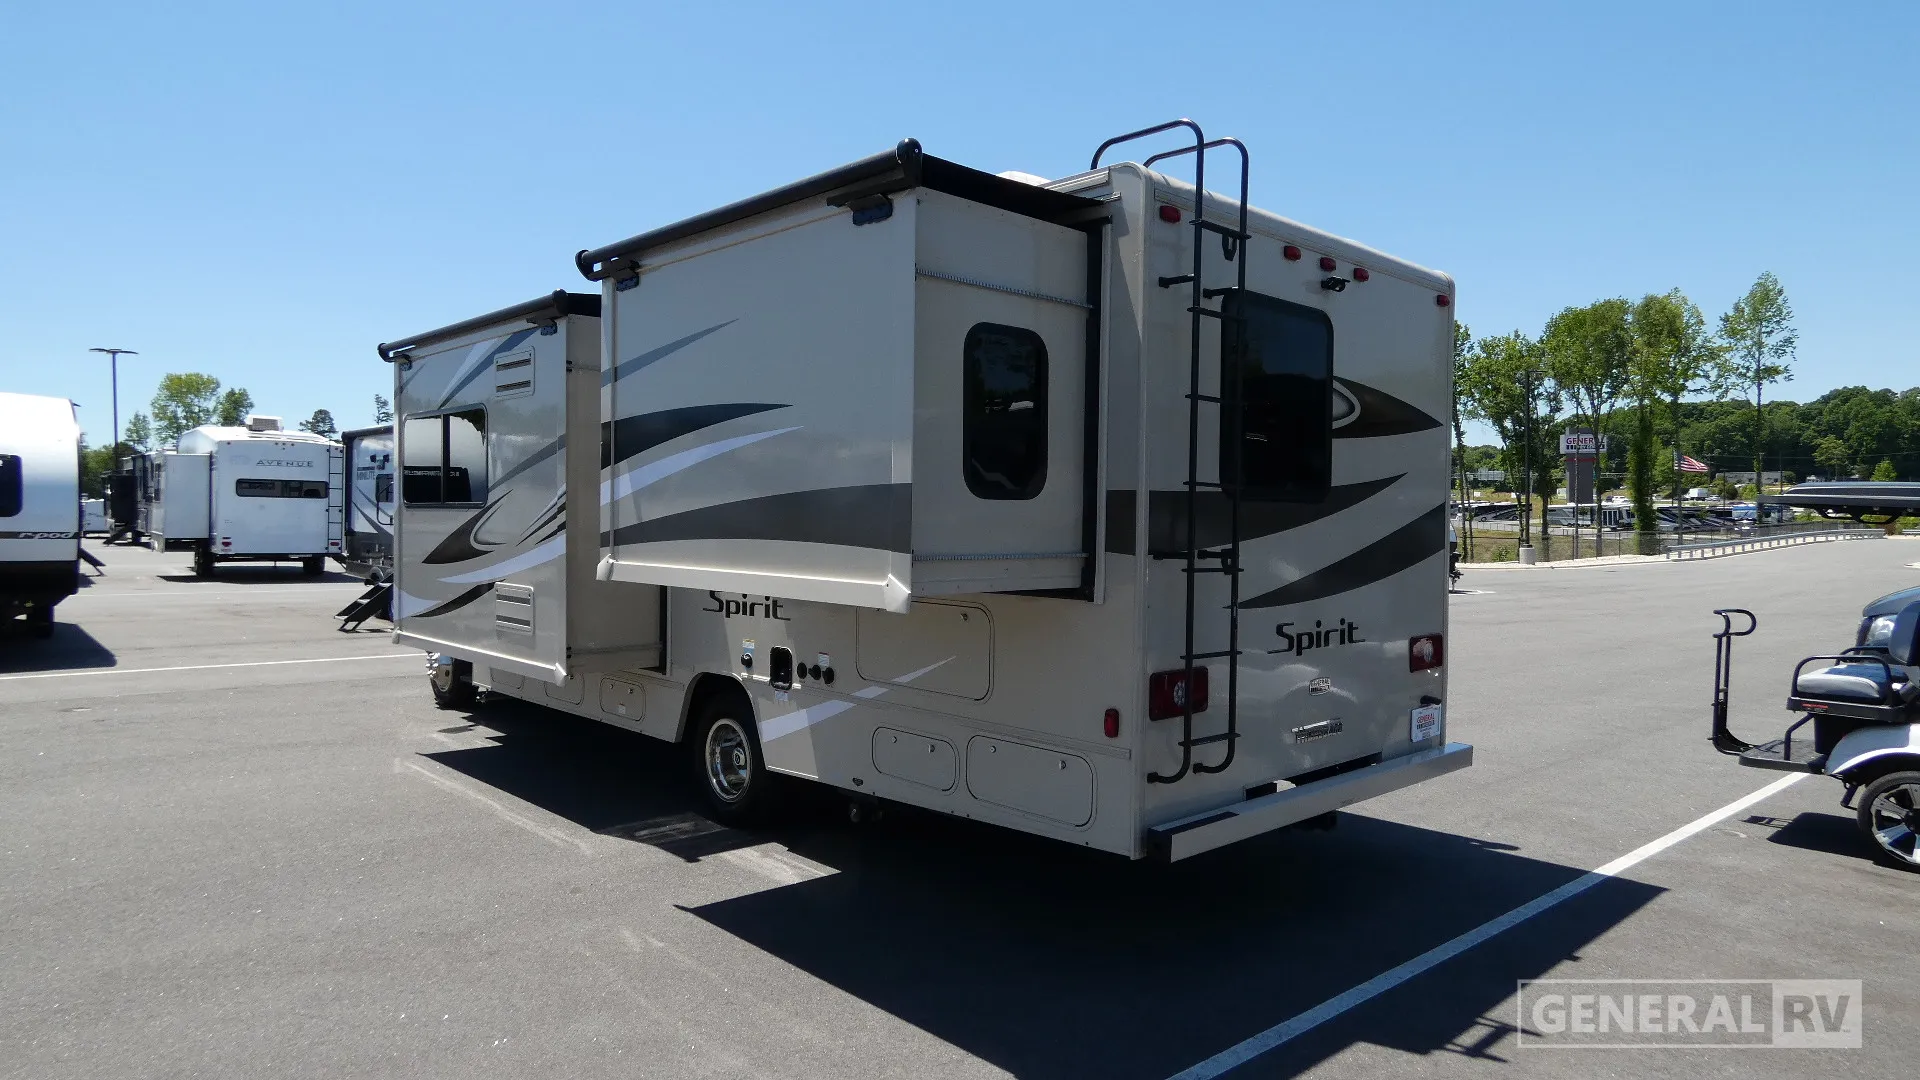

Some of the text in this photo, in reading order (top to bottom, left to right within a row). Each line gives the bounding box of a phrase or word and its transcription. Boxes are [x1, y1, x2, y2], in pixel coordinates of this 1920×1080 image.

[256, 459, 314, 468] AVENUE
[702, 590, 791, 621] Spirit
[1266, 617, 1366, 656] Spirit
